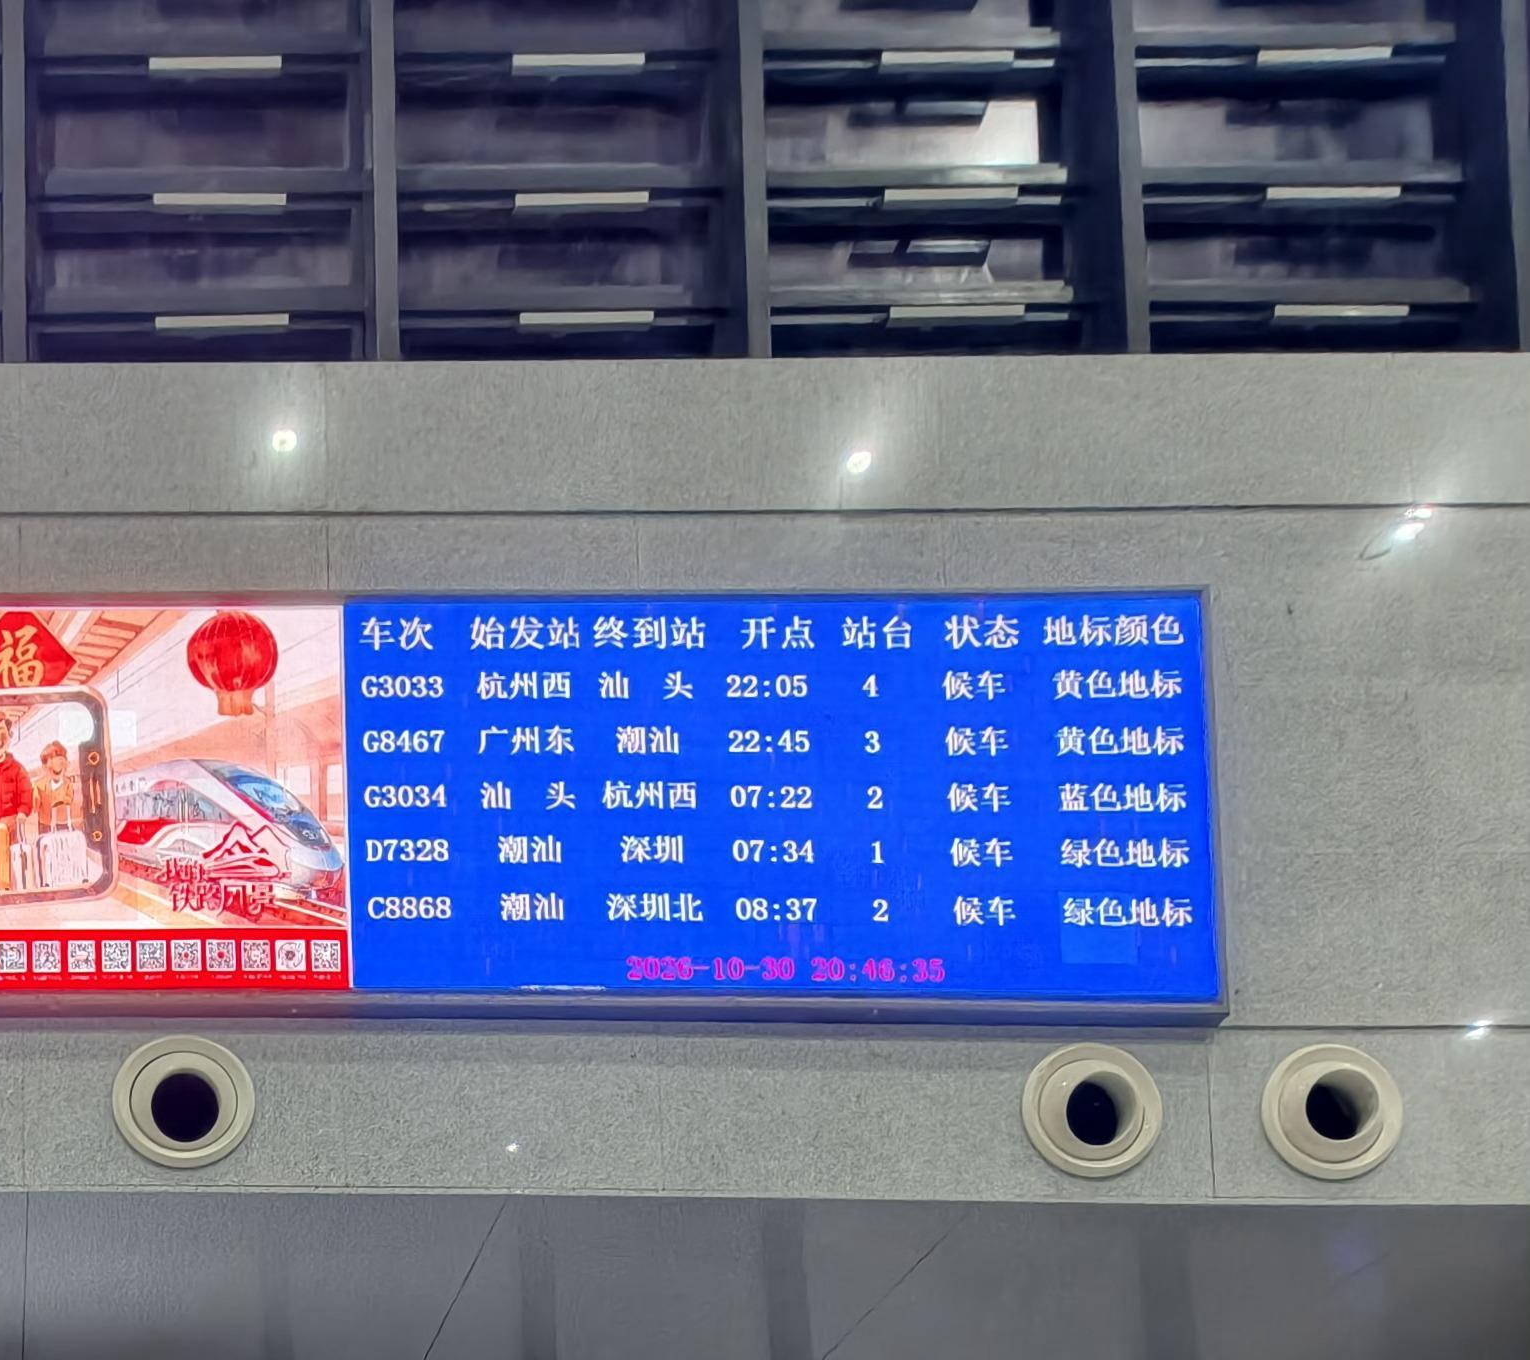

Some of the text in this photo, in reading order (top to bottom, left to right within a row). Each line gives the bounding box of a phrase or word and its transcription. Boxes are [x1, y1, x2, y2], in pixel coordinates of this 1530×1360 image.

[361, 614, 1184, 650] 车次 始发站 终到站 开点 站台 状态 地标颜色
[361, 670, 1182, 700] G3033 杭州西 汕头 22:05 4 候车 黄色地标
[363, 725, 1184, 756] G8467 广州东 潮汕 22:45 3 候车 黄色地标
[364, 781, 1186, 812] G3034 汕头 杭州西 07:22 2 候车 蓝色地标
[366, 835, 1189, 868] D7328 潮汕 深圳 07:34 1 候车 绿色地标
[368, 893, 1192, 927] C8868 潮汕 深圳北 08:37 2 候车 绿色地标
[626, 956, 795, 980] 2026-10-30
